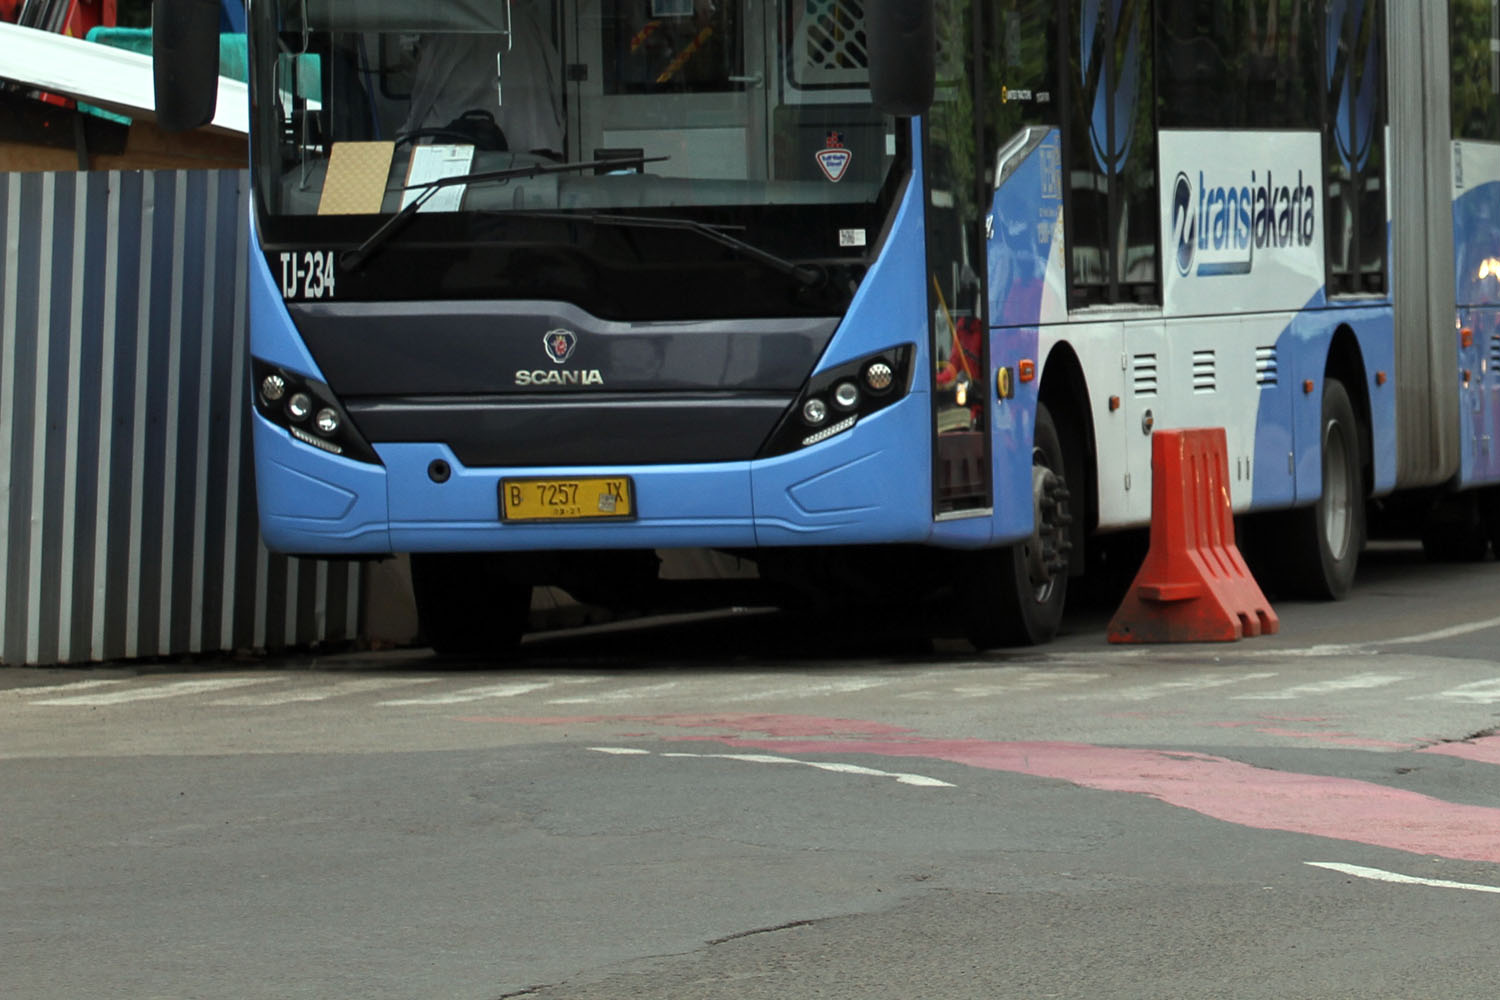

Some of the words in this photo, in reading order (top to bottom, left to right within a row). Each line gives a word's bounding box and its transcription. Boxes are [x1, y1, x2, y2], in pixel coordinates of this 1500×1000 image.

[1198, 170, 1314, 274] transjakarta
[280, 251, 335, 298] TJ-234
[515, 369, 604, 385] SCANIA
[510, 485, 522, 507] B
[536, 483, 579, 506] 7257
